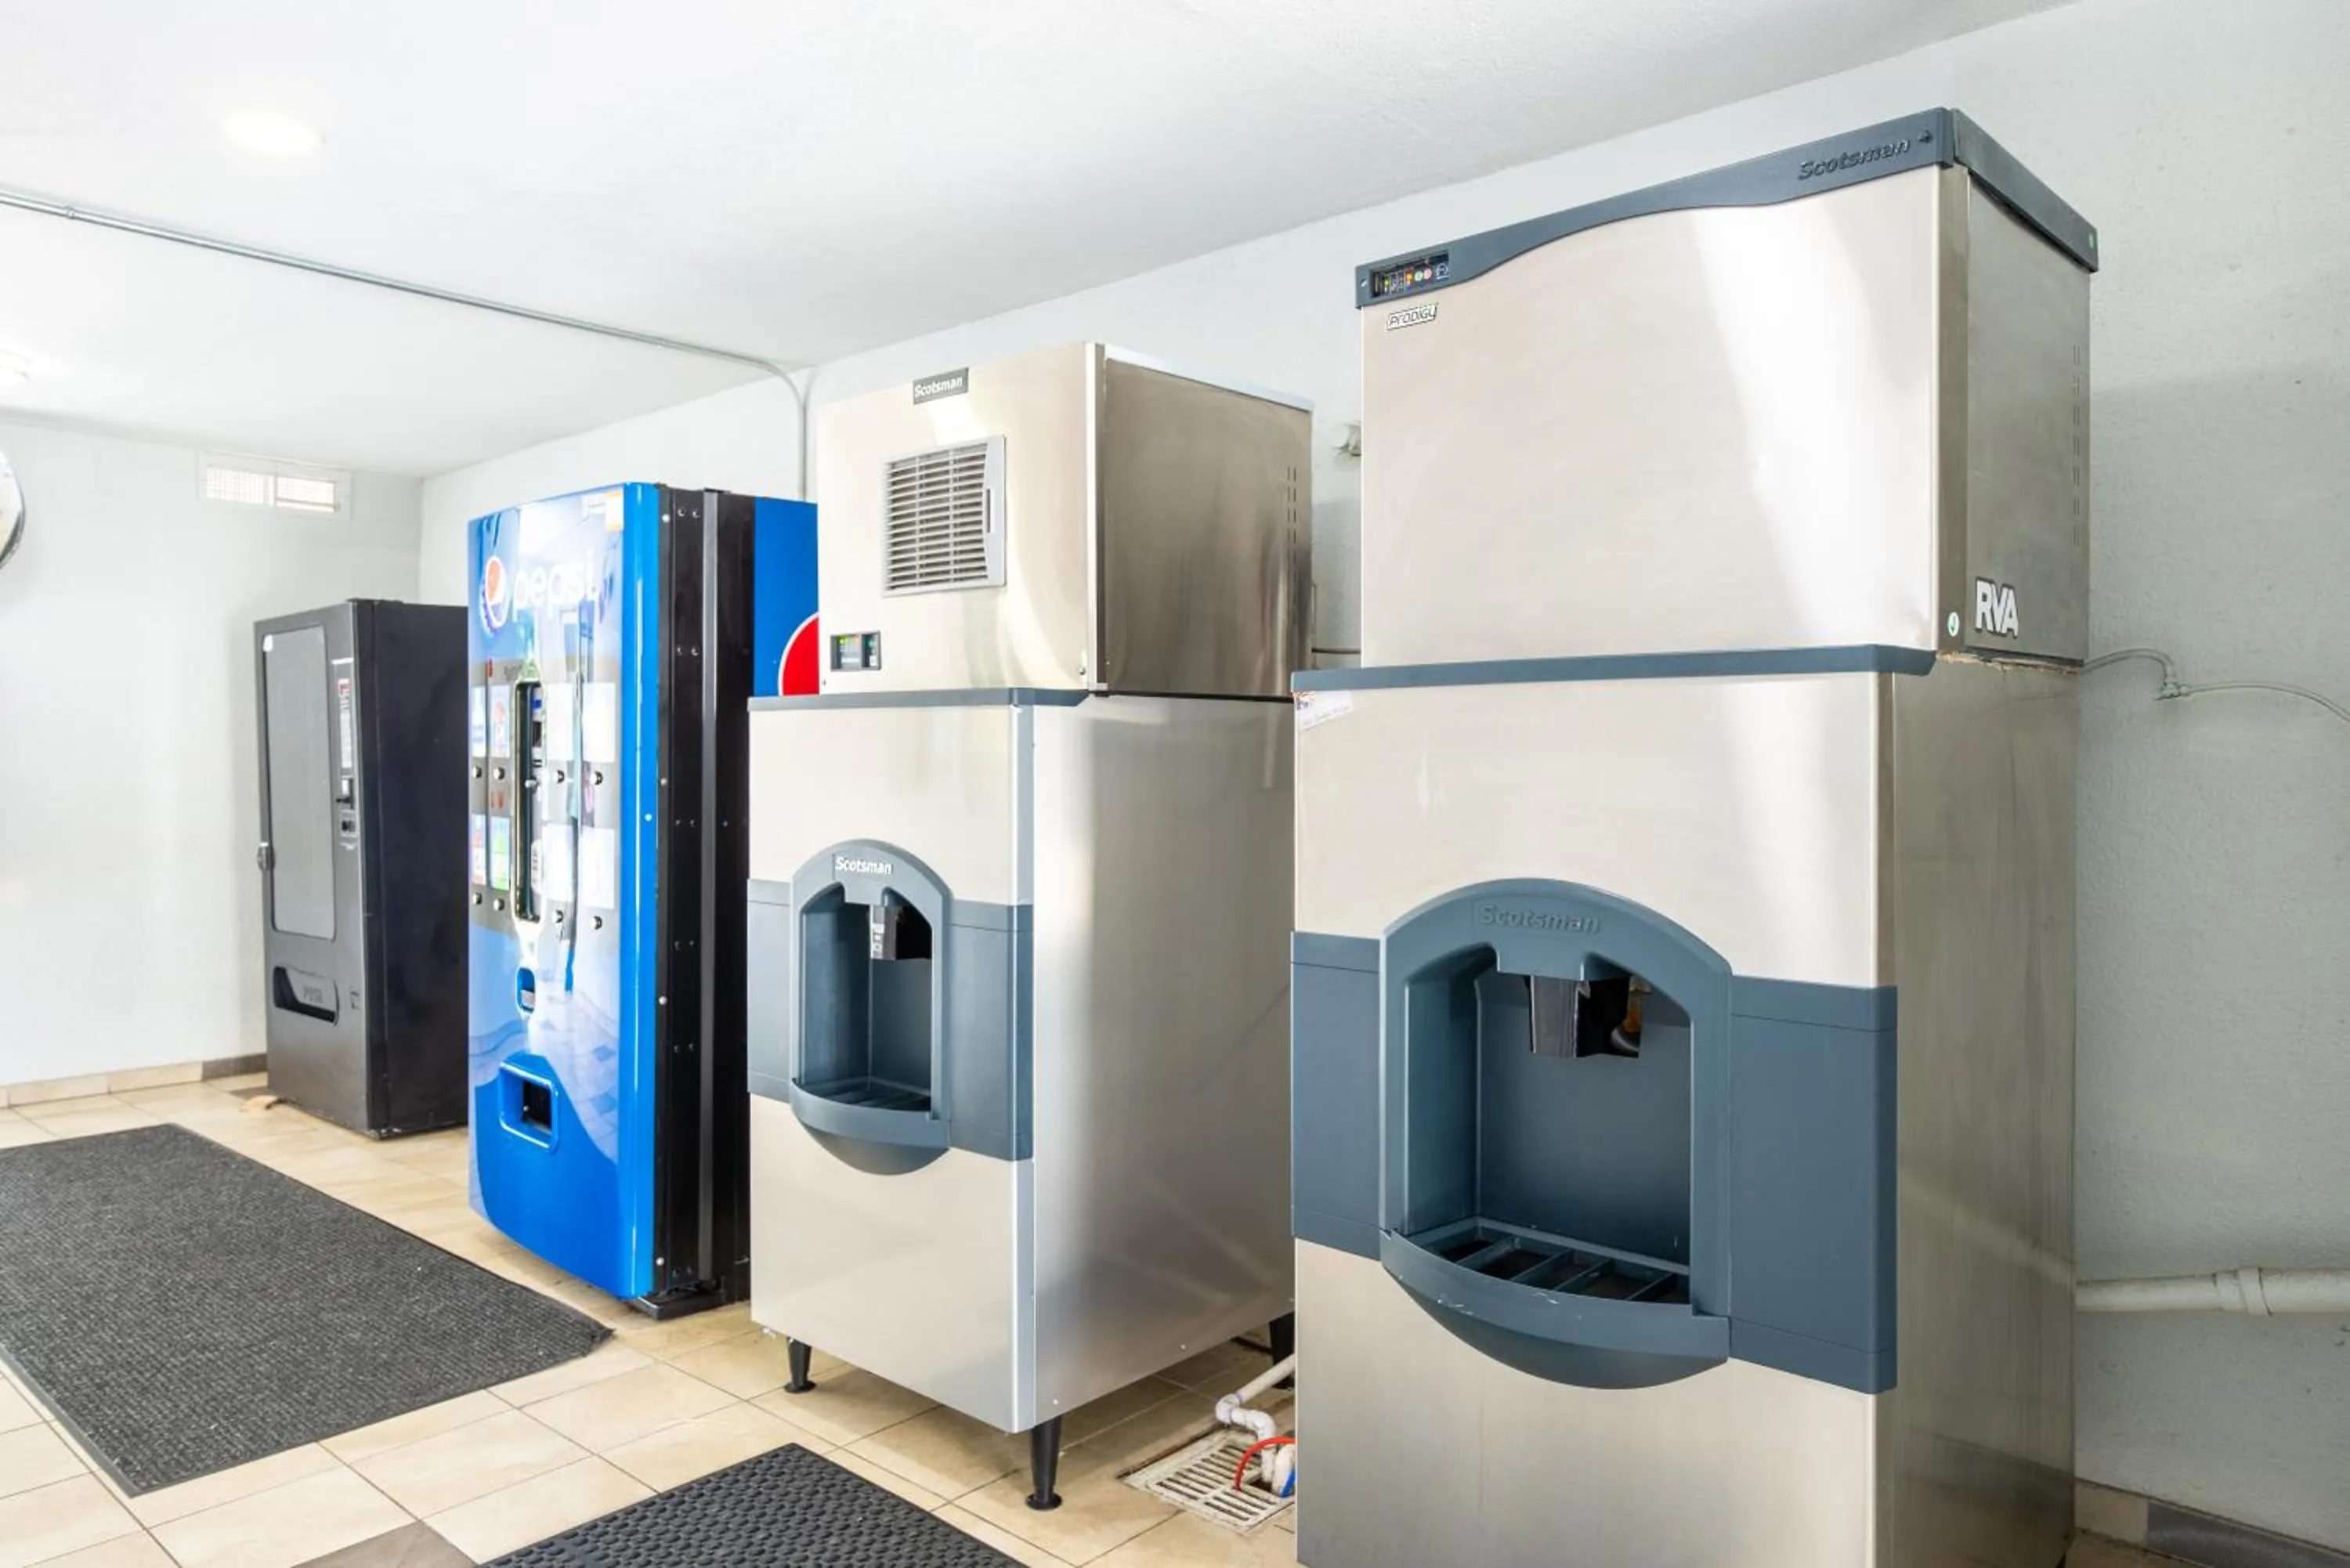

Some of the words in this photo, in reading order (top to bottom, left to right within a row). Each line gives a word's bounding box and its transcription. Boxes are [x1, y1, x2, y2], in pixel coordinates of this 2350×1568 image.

[1797, 138, 1911, 180] Scotsman
[914, 377, 963, 398] Scotsman
[1975, 576, 2019, 640] RVA
[834, 857, 892, 875] Scotsman
[1479, 905, 1601, 934] Scotsman
